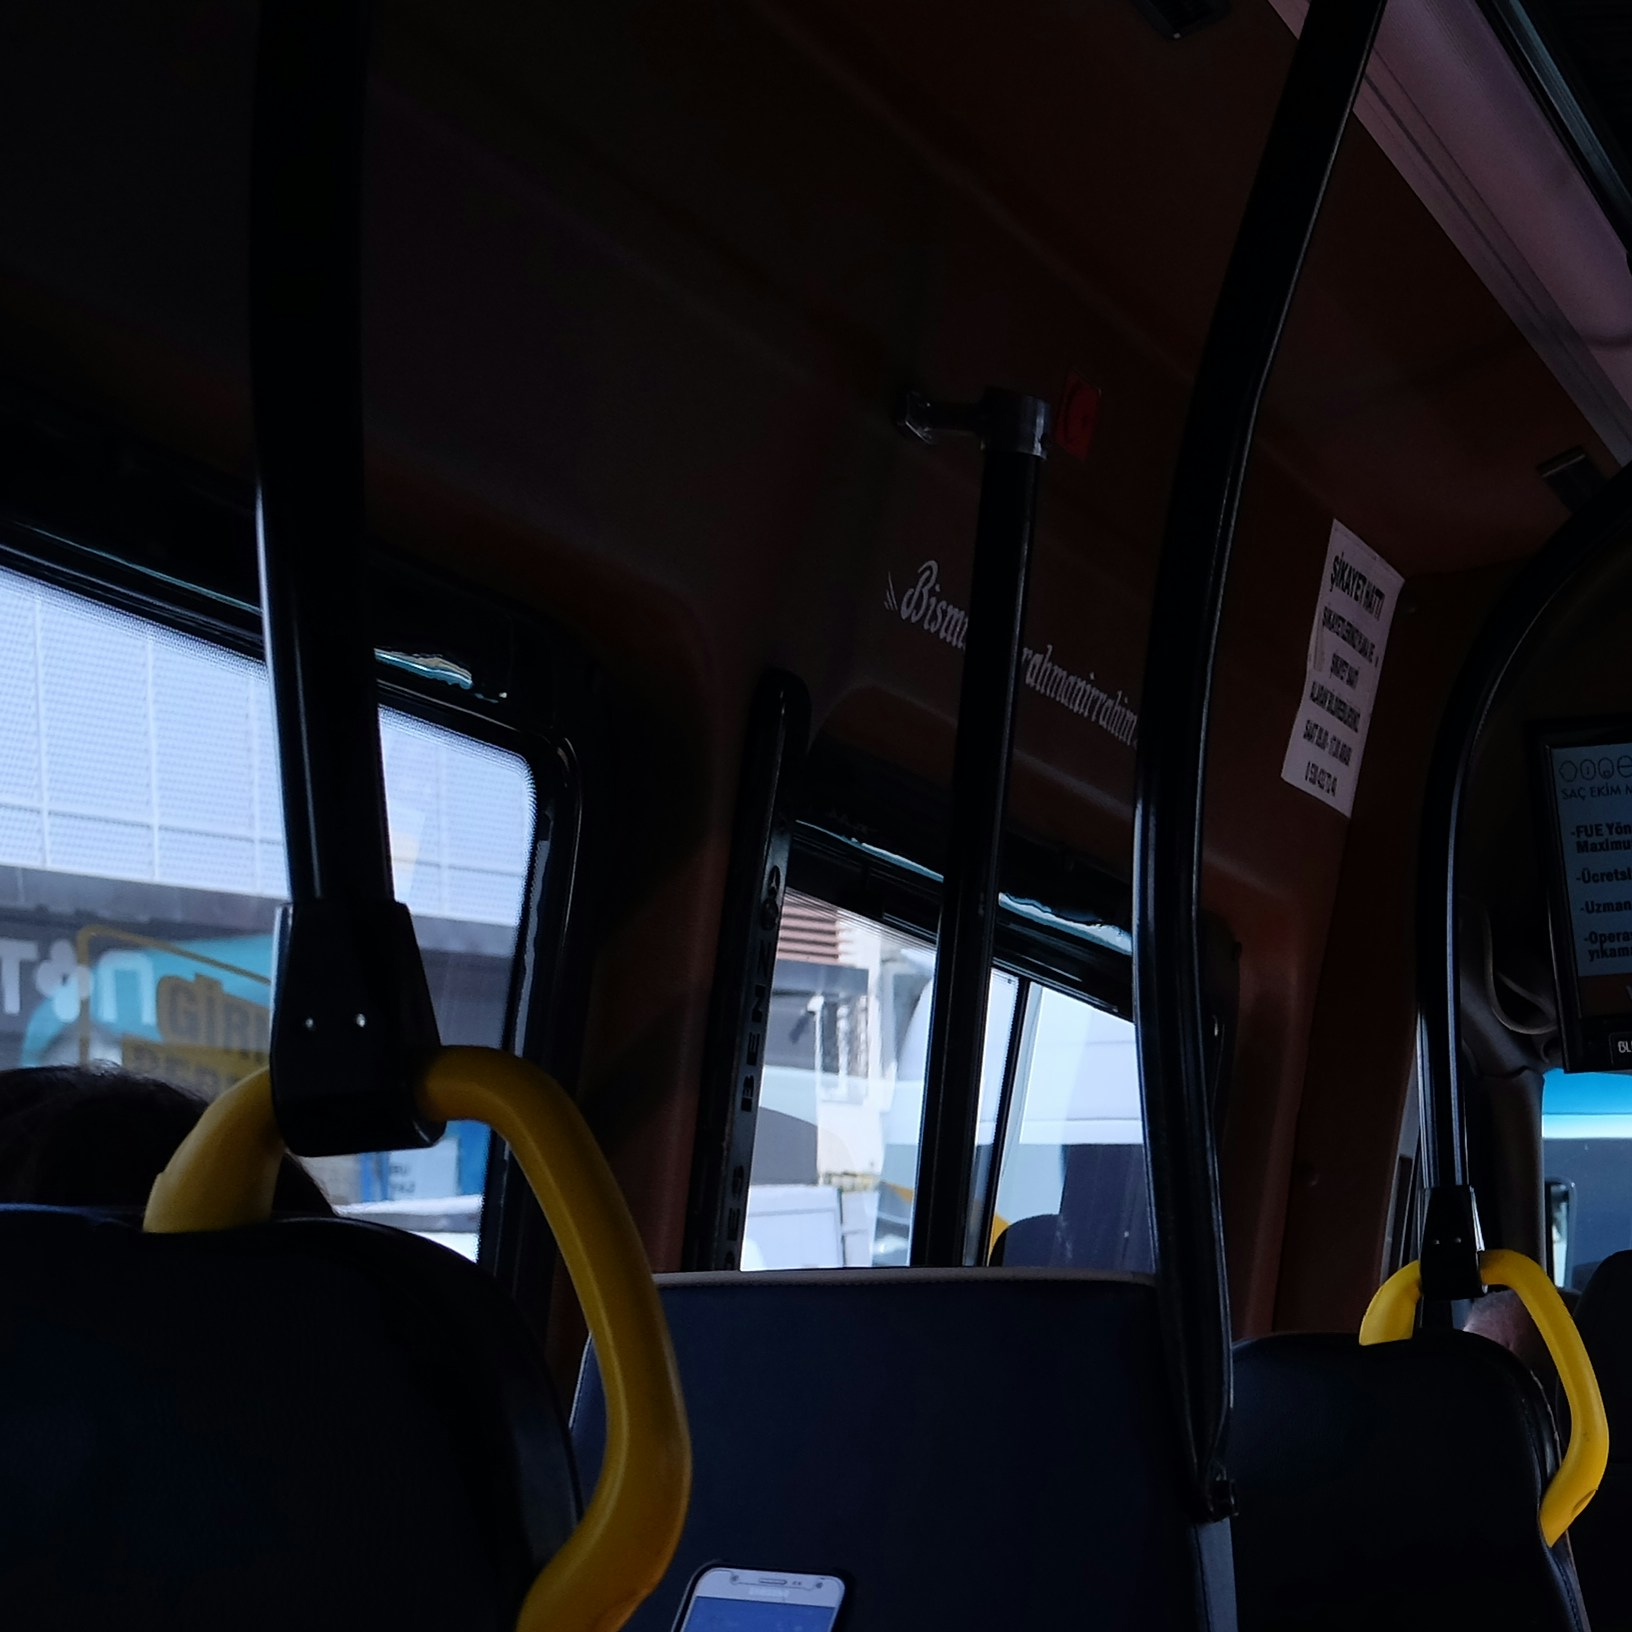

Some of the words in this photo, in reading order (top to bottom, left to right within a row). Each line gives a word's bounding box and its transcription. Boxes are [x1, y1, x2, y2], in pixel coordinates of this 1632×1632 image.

[1561, 787, 1588, 801] SAÇ
[1590, 782, 1622, 797] EKİM
[740, 936, 772, 1116] BENZ
